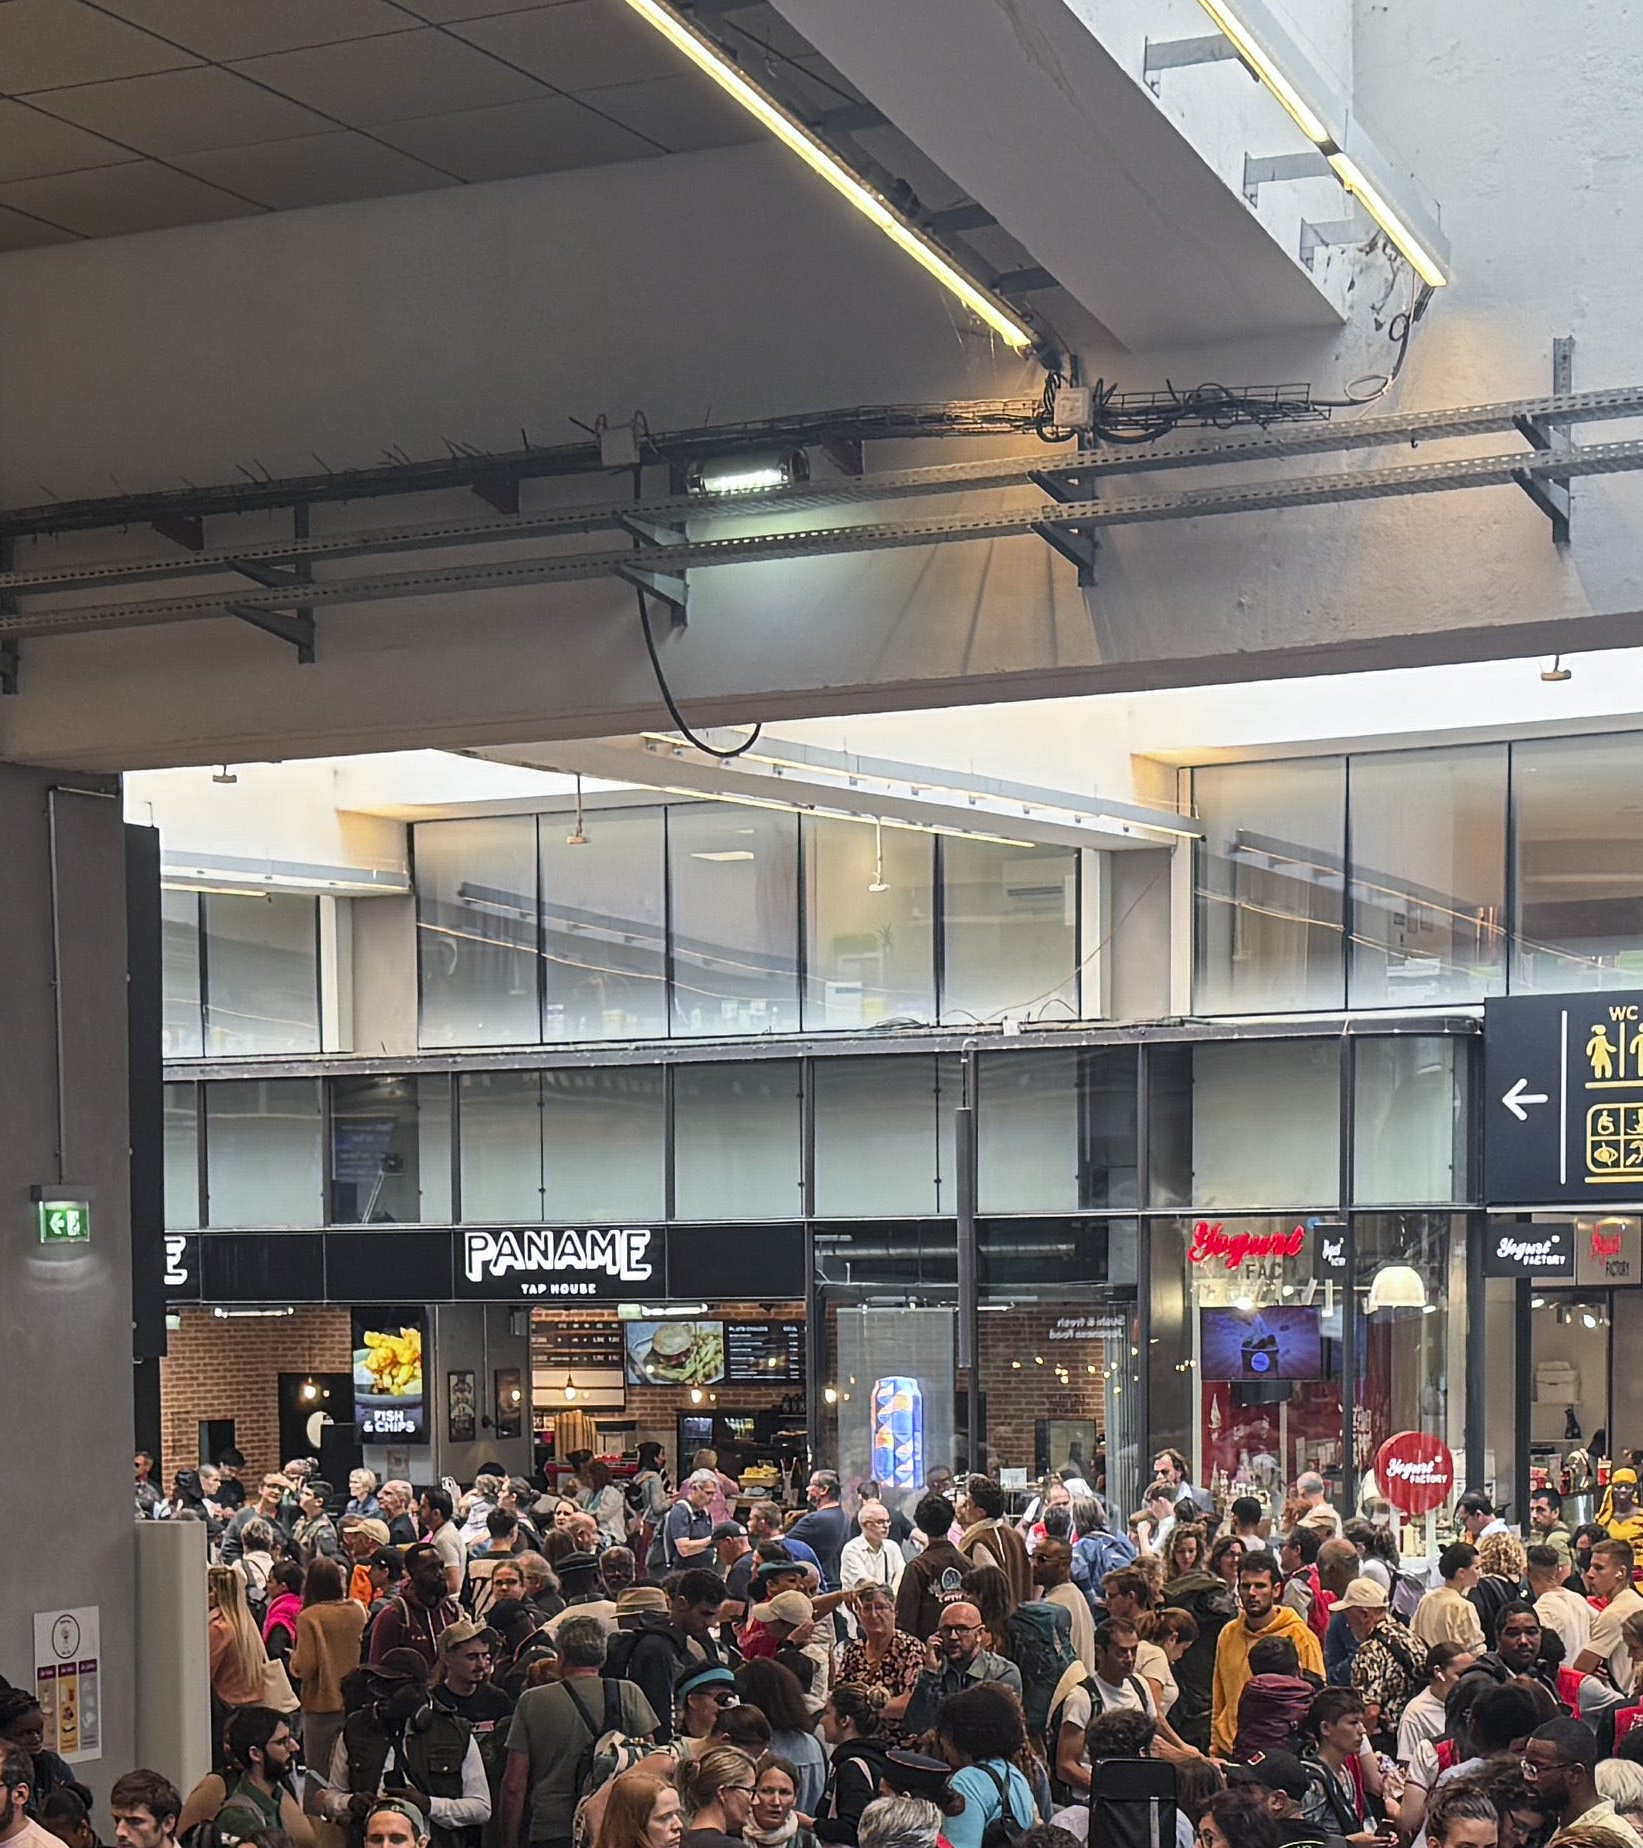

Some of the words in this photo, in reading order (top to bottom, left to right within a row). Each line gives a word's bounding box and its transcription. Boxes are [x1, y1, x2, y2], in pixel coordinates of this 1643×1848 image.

[1608, 1006, 1639, 1022] WC
[1188, 1222, 1306, 1270] Yogurt
[464, 1229, 653, 1282] PANAME
[521, 1283, 546, 1295] TAP
[550, 1283, 597, 1295] HOUSE
[374, 1410, 403, 1421] FISH
[363, 1421, 373, 1432] &
[375, 1421, 415, 1432] CHIPS
[1386, 1458, 1433, 1480] Yogurt
[1410, 1474, 1447, 1484] FACTORY
